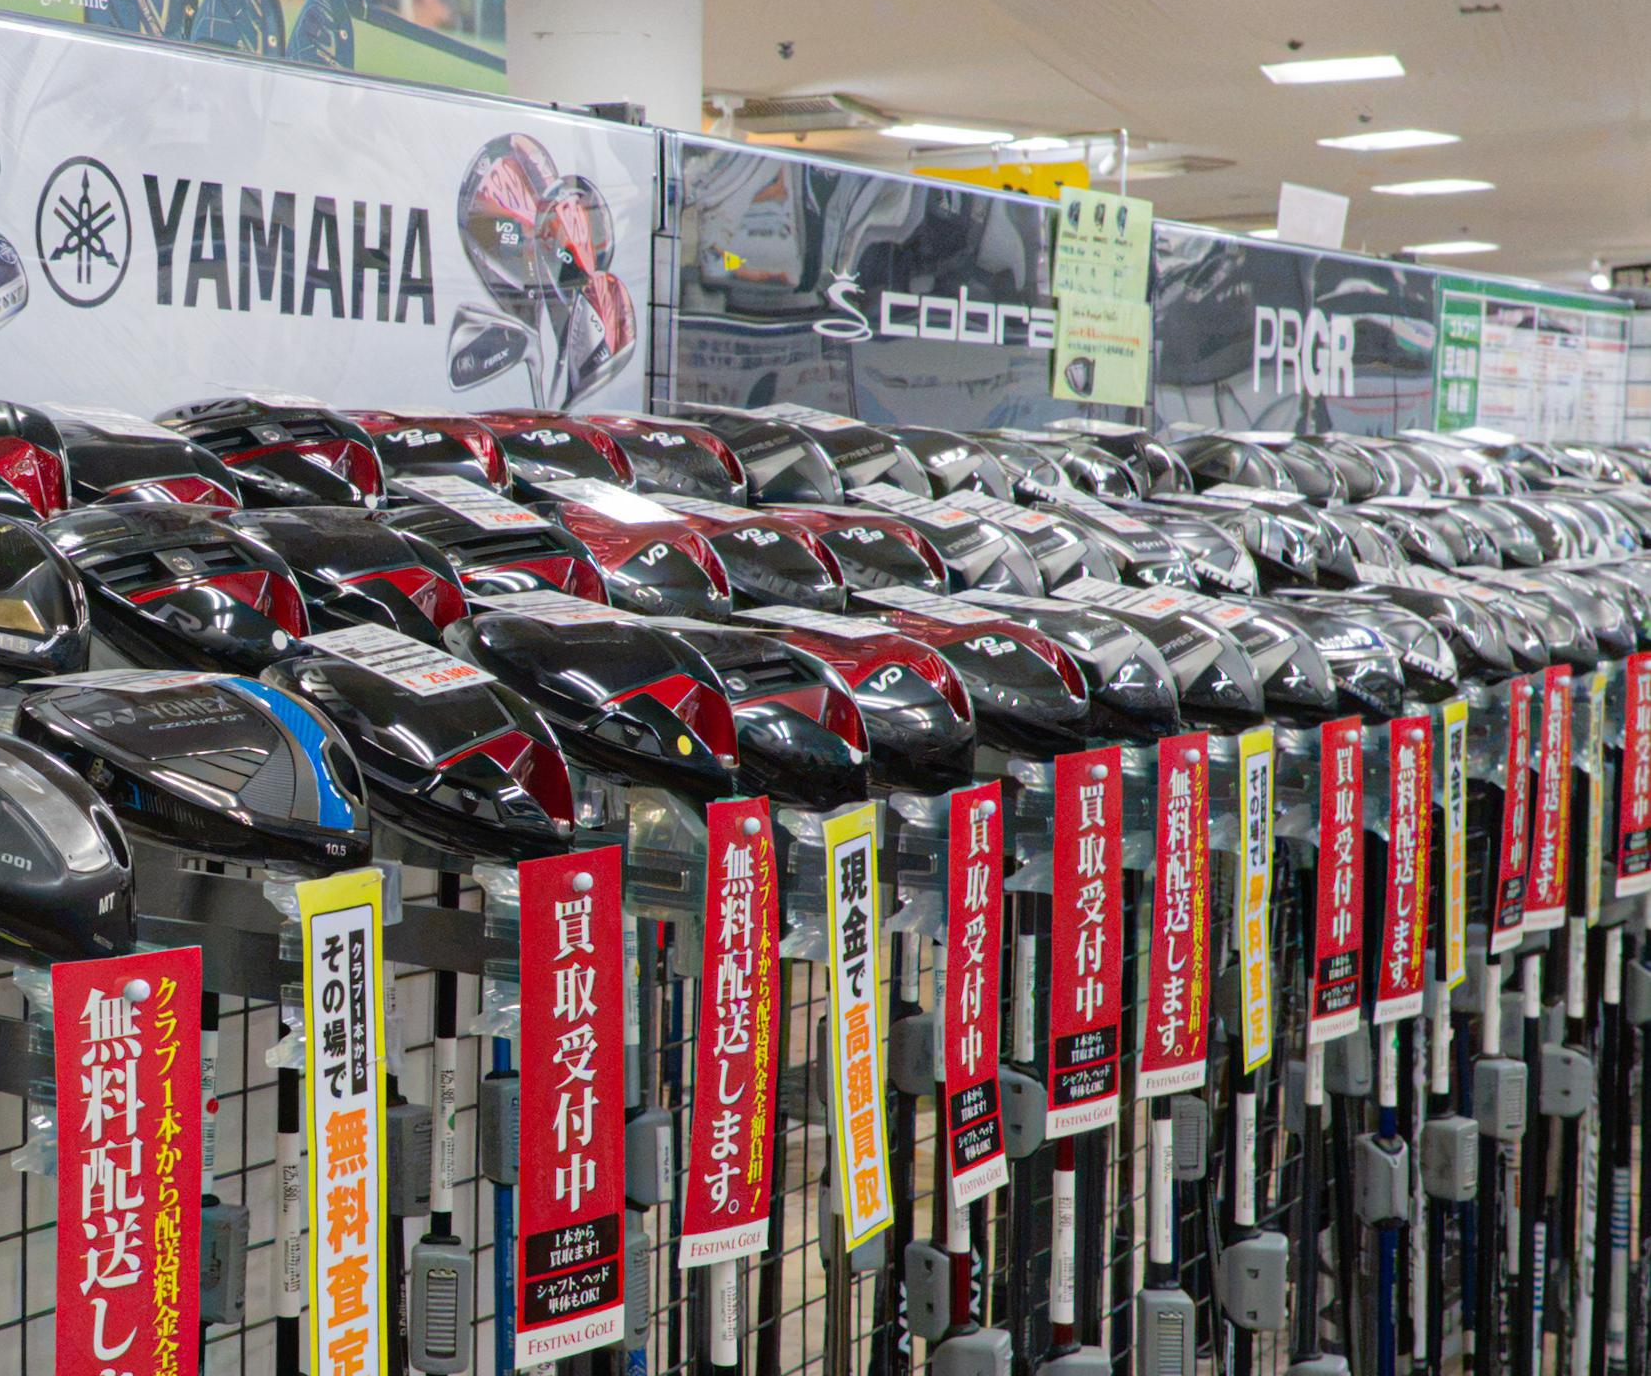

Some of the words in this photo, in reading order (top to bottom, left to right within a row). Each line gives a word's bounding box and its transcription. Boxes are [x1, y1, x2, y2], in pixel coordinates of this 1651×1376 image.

[143, 174, 436, 325] YAMAHA
[881, 286, 1056, 348] cobra
[1254, 306, 1355, 396] PRGR
[869, 667, 903, 691] VD
[325, 843, 347, 856] 10.5
[1075, 783, 1107, 1024] 買取受付中
[351, 942, 366, 1079] クラブ1本から
[704, 842, 754, 1215] 無料配送します。
[840, 847, 883, 1219] 現金で高額買取
[553, 895, 599, 1212] 買取受付中
[555, 1225, 594, 1249] 1本から
[691, 1236, 736, 1258] FESTIVAL
[739, 1230, 762, 1249] GOLF
[537, 1266, 610, 1300] シャフト、ヘッド
[528, 1331, 581, 1356] FESTIVAL
[585, 1319, 615, 1341] GOLF
